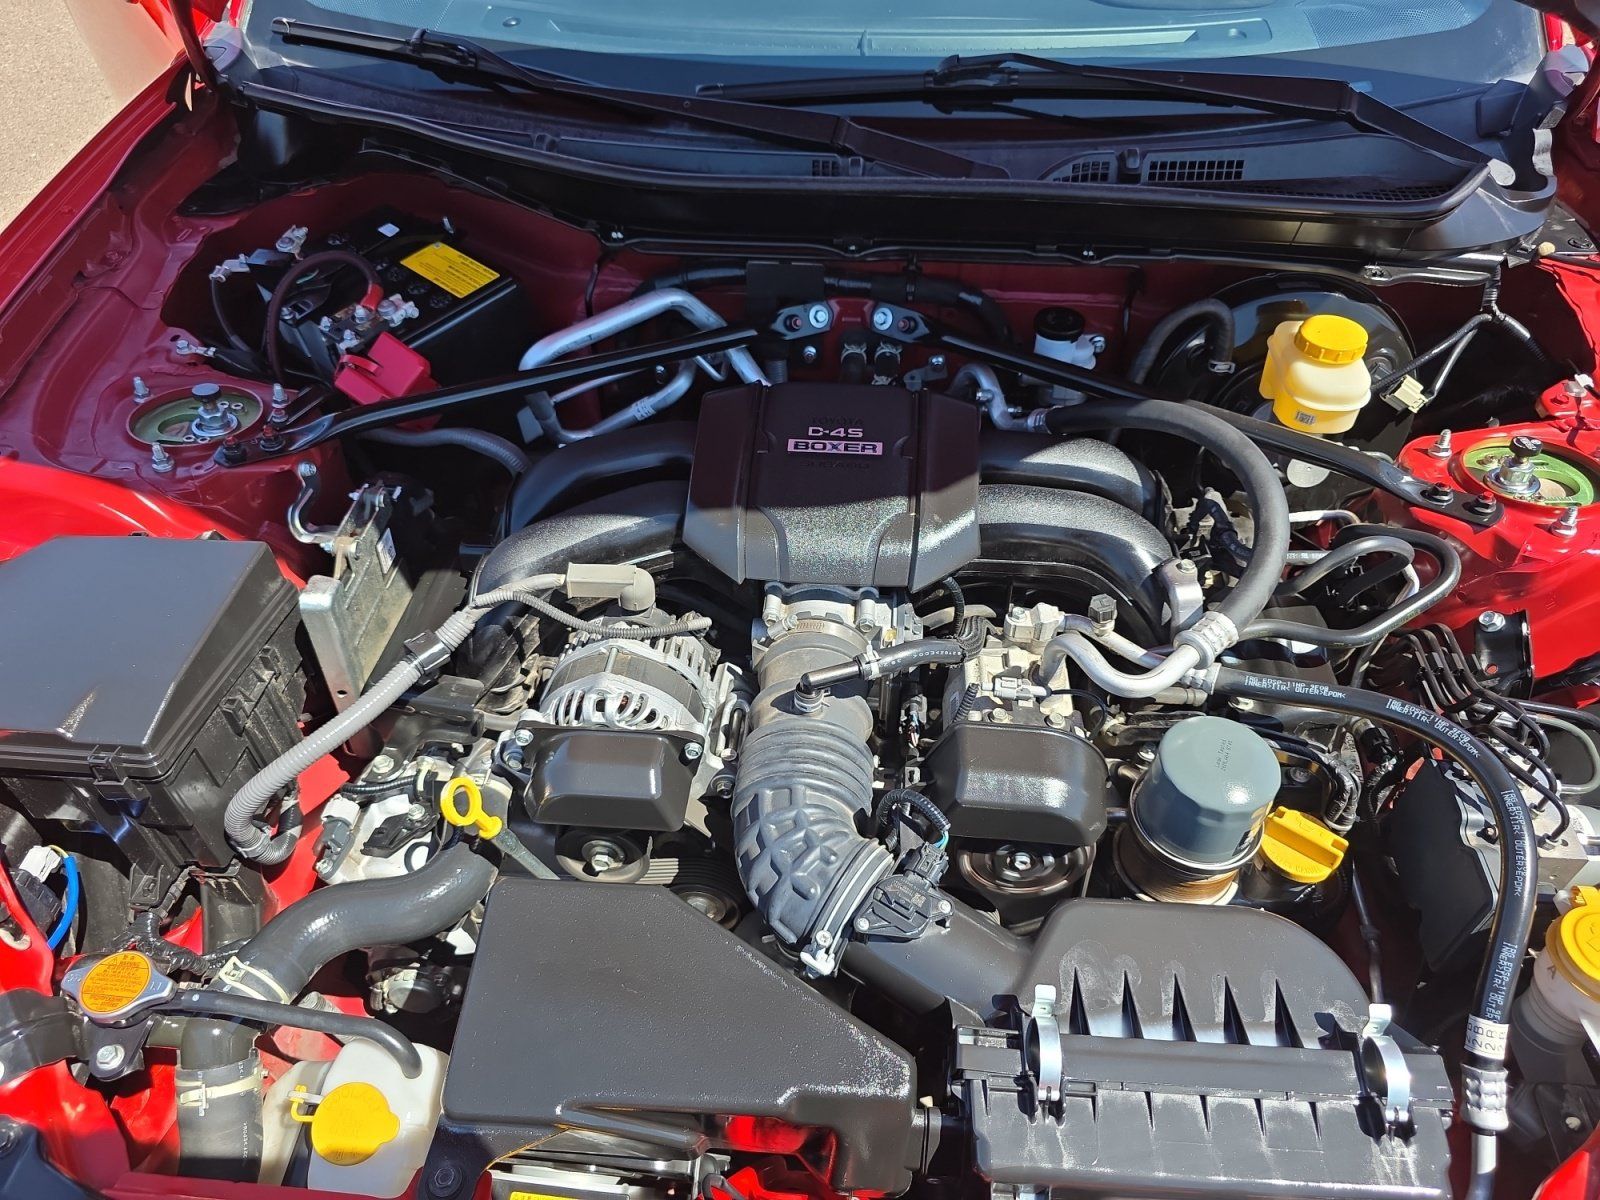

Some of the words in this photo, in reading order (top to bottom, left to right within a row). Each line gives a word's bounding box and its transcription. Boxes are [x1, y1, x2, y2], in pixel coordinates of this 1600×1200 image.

[807, 426, 864, 438] D-4S
[793, 440, 878, 453] BOXER
[1513, 840, 1526, 897] OUTER>EPDM<
